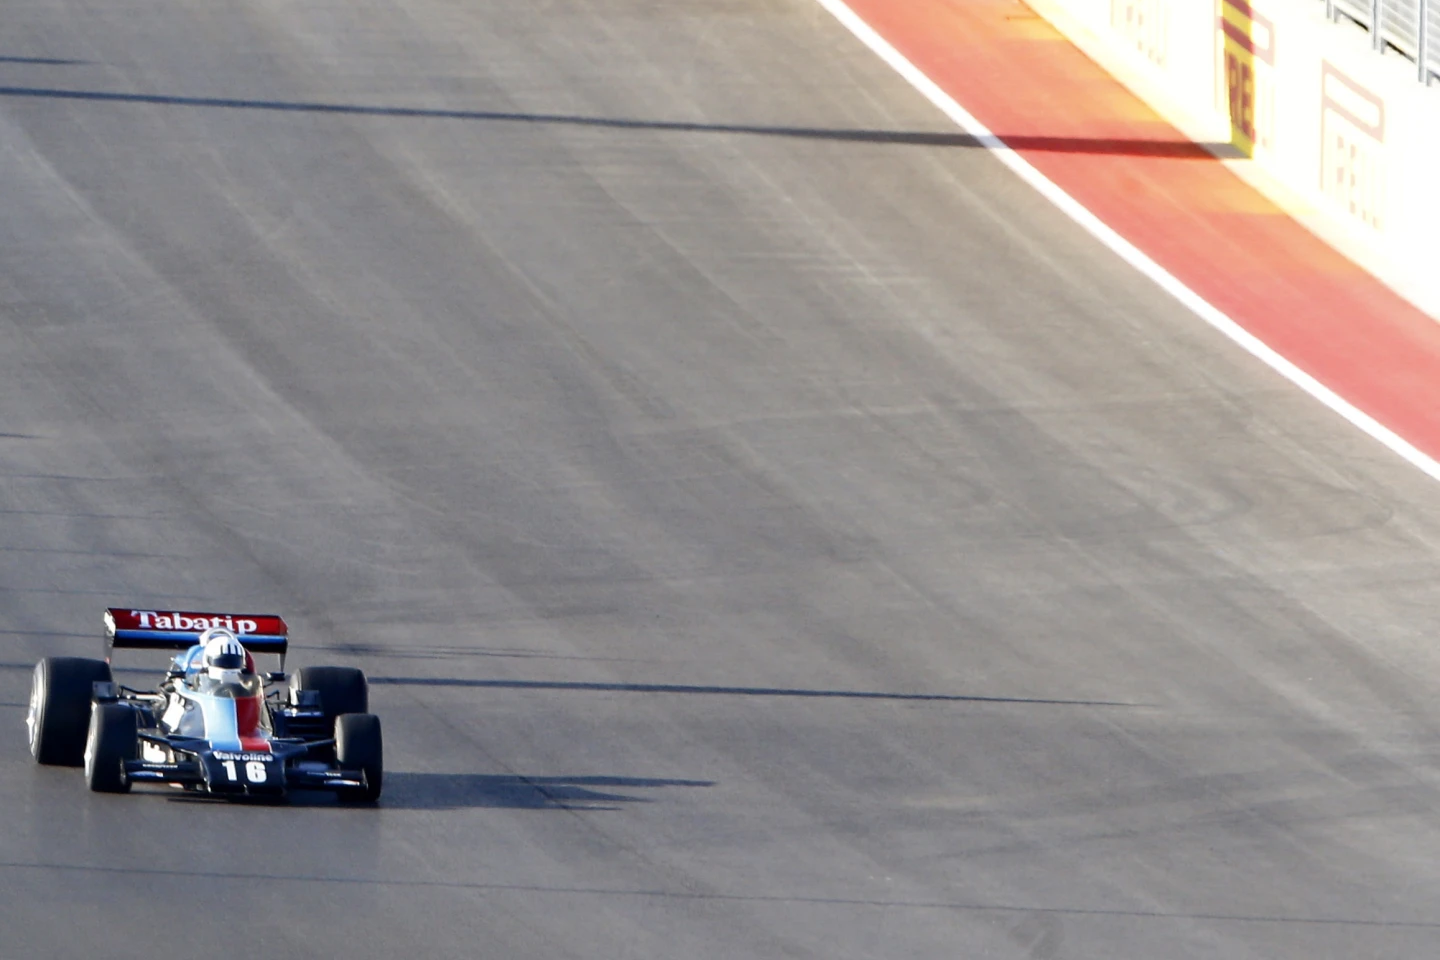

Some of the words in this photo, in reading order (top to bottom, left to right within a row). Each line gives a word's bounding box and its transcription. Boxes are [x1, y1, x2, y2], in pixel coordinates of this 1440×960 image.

[131, 609, 257, 634] Tabatip
[212, 750, 274, 762] Valvoline
[221, 760, 267, 783] 16
